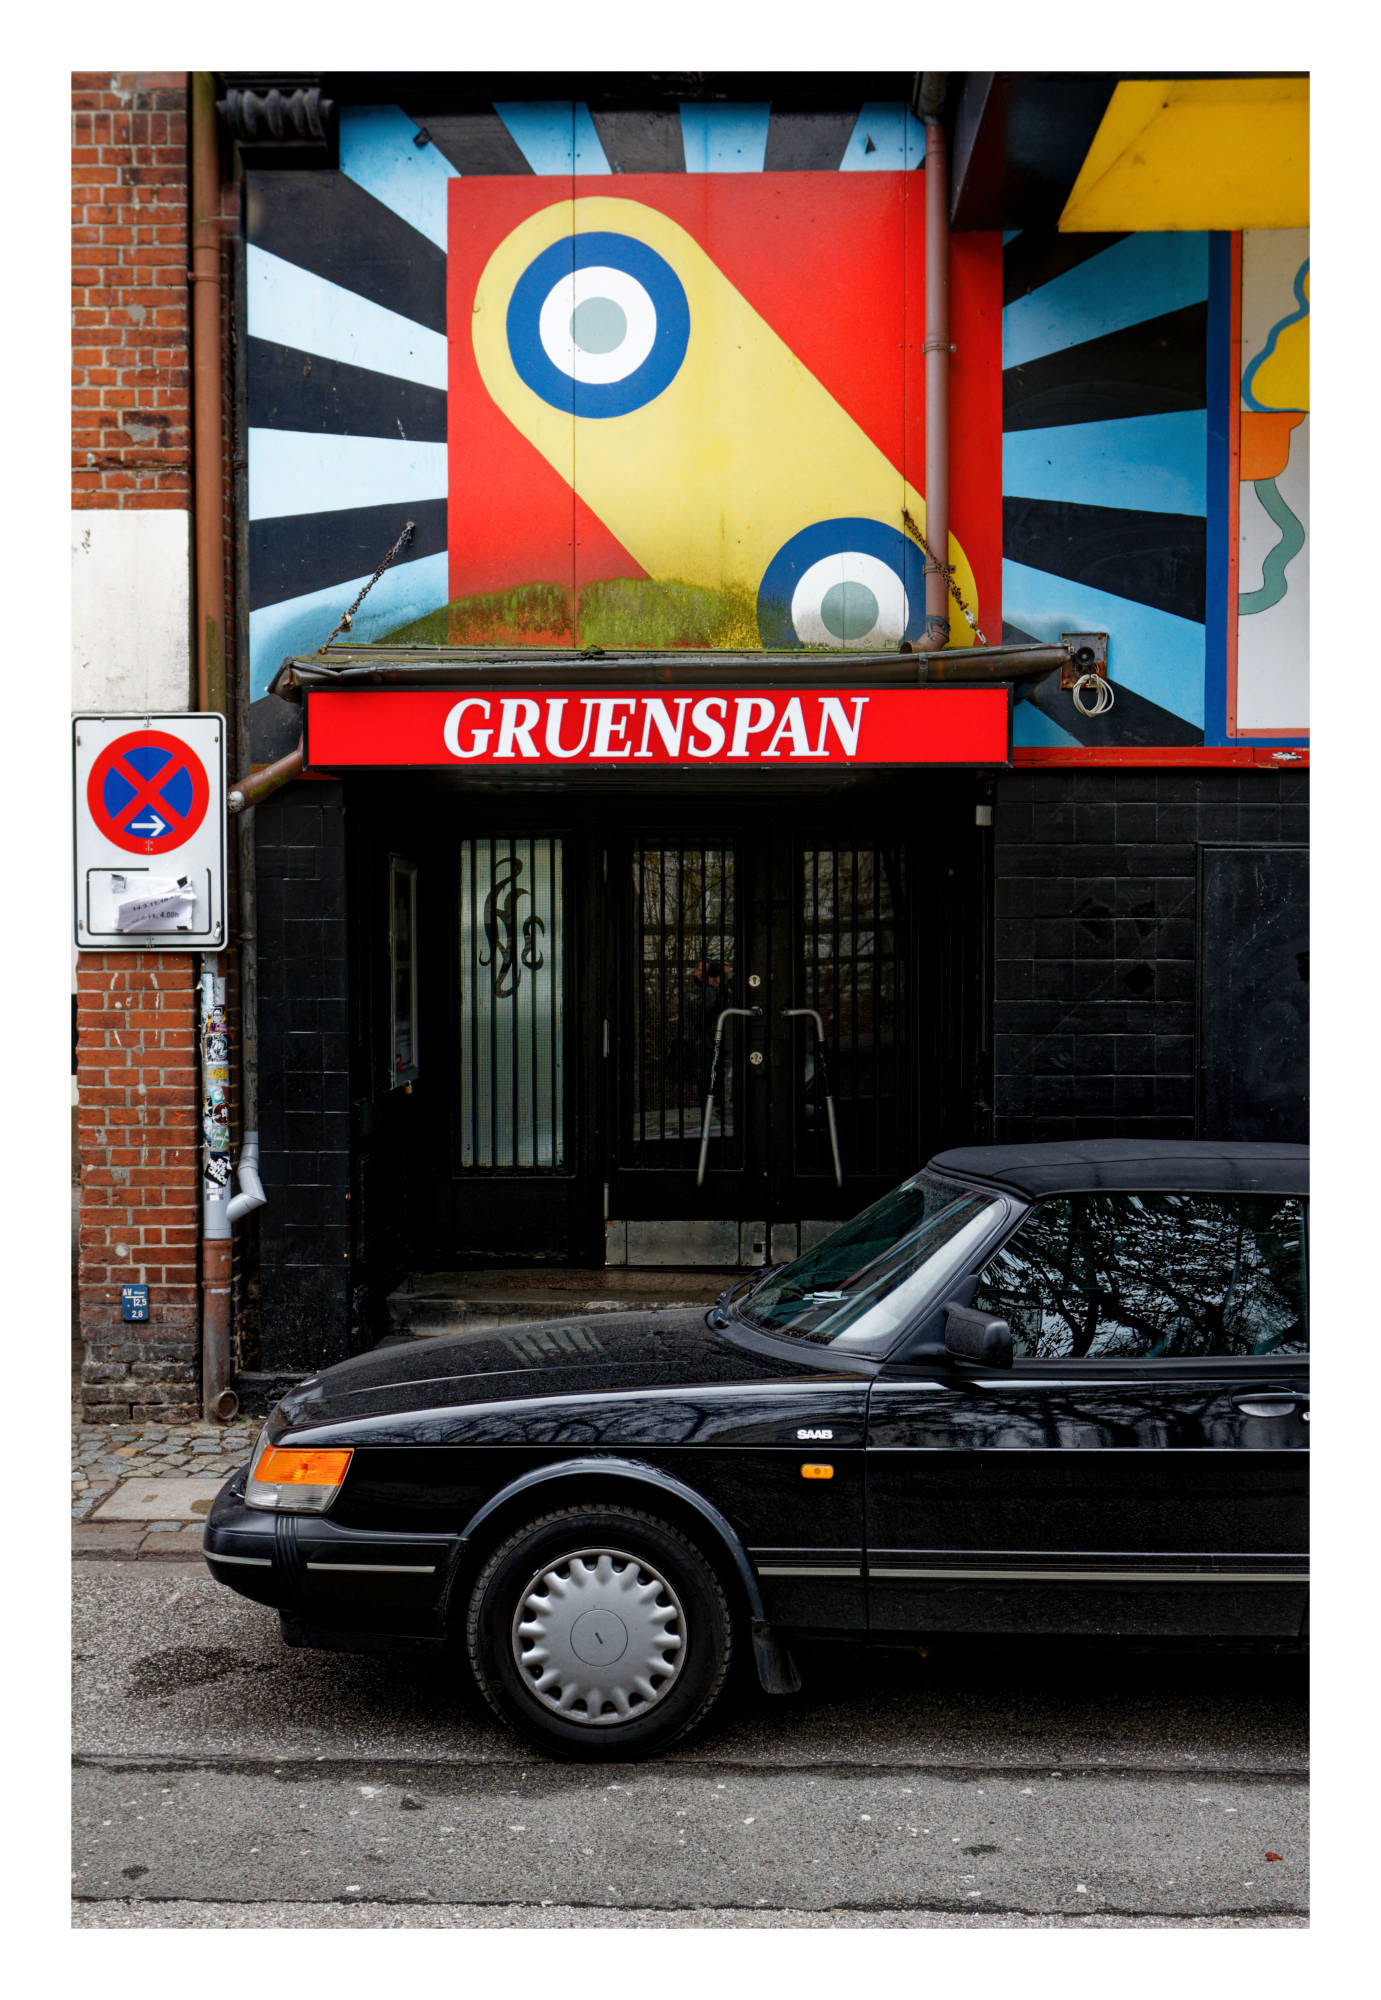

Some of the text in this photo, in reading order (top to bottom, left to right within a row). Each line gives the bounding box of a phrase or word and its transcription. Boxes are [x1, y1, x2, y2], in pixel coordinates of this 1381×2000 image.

[443, 697, 870, 758] GRUENSPAN
[122, 1288, 132, 1297] AV
[796, 1429, 833, 1440] SAAB
